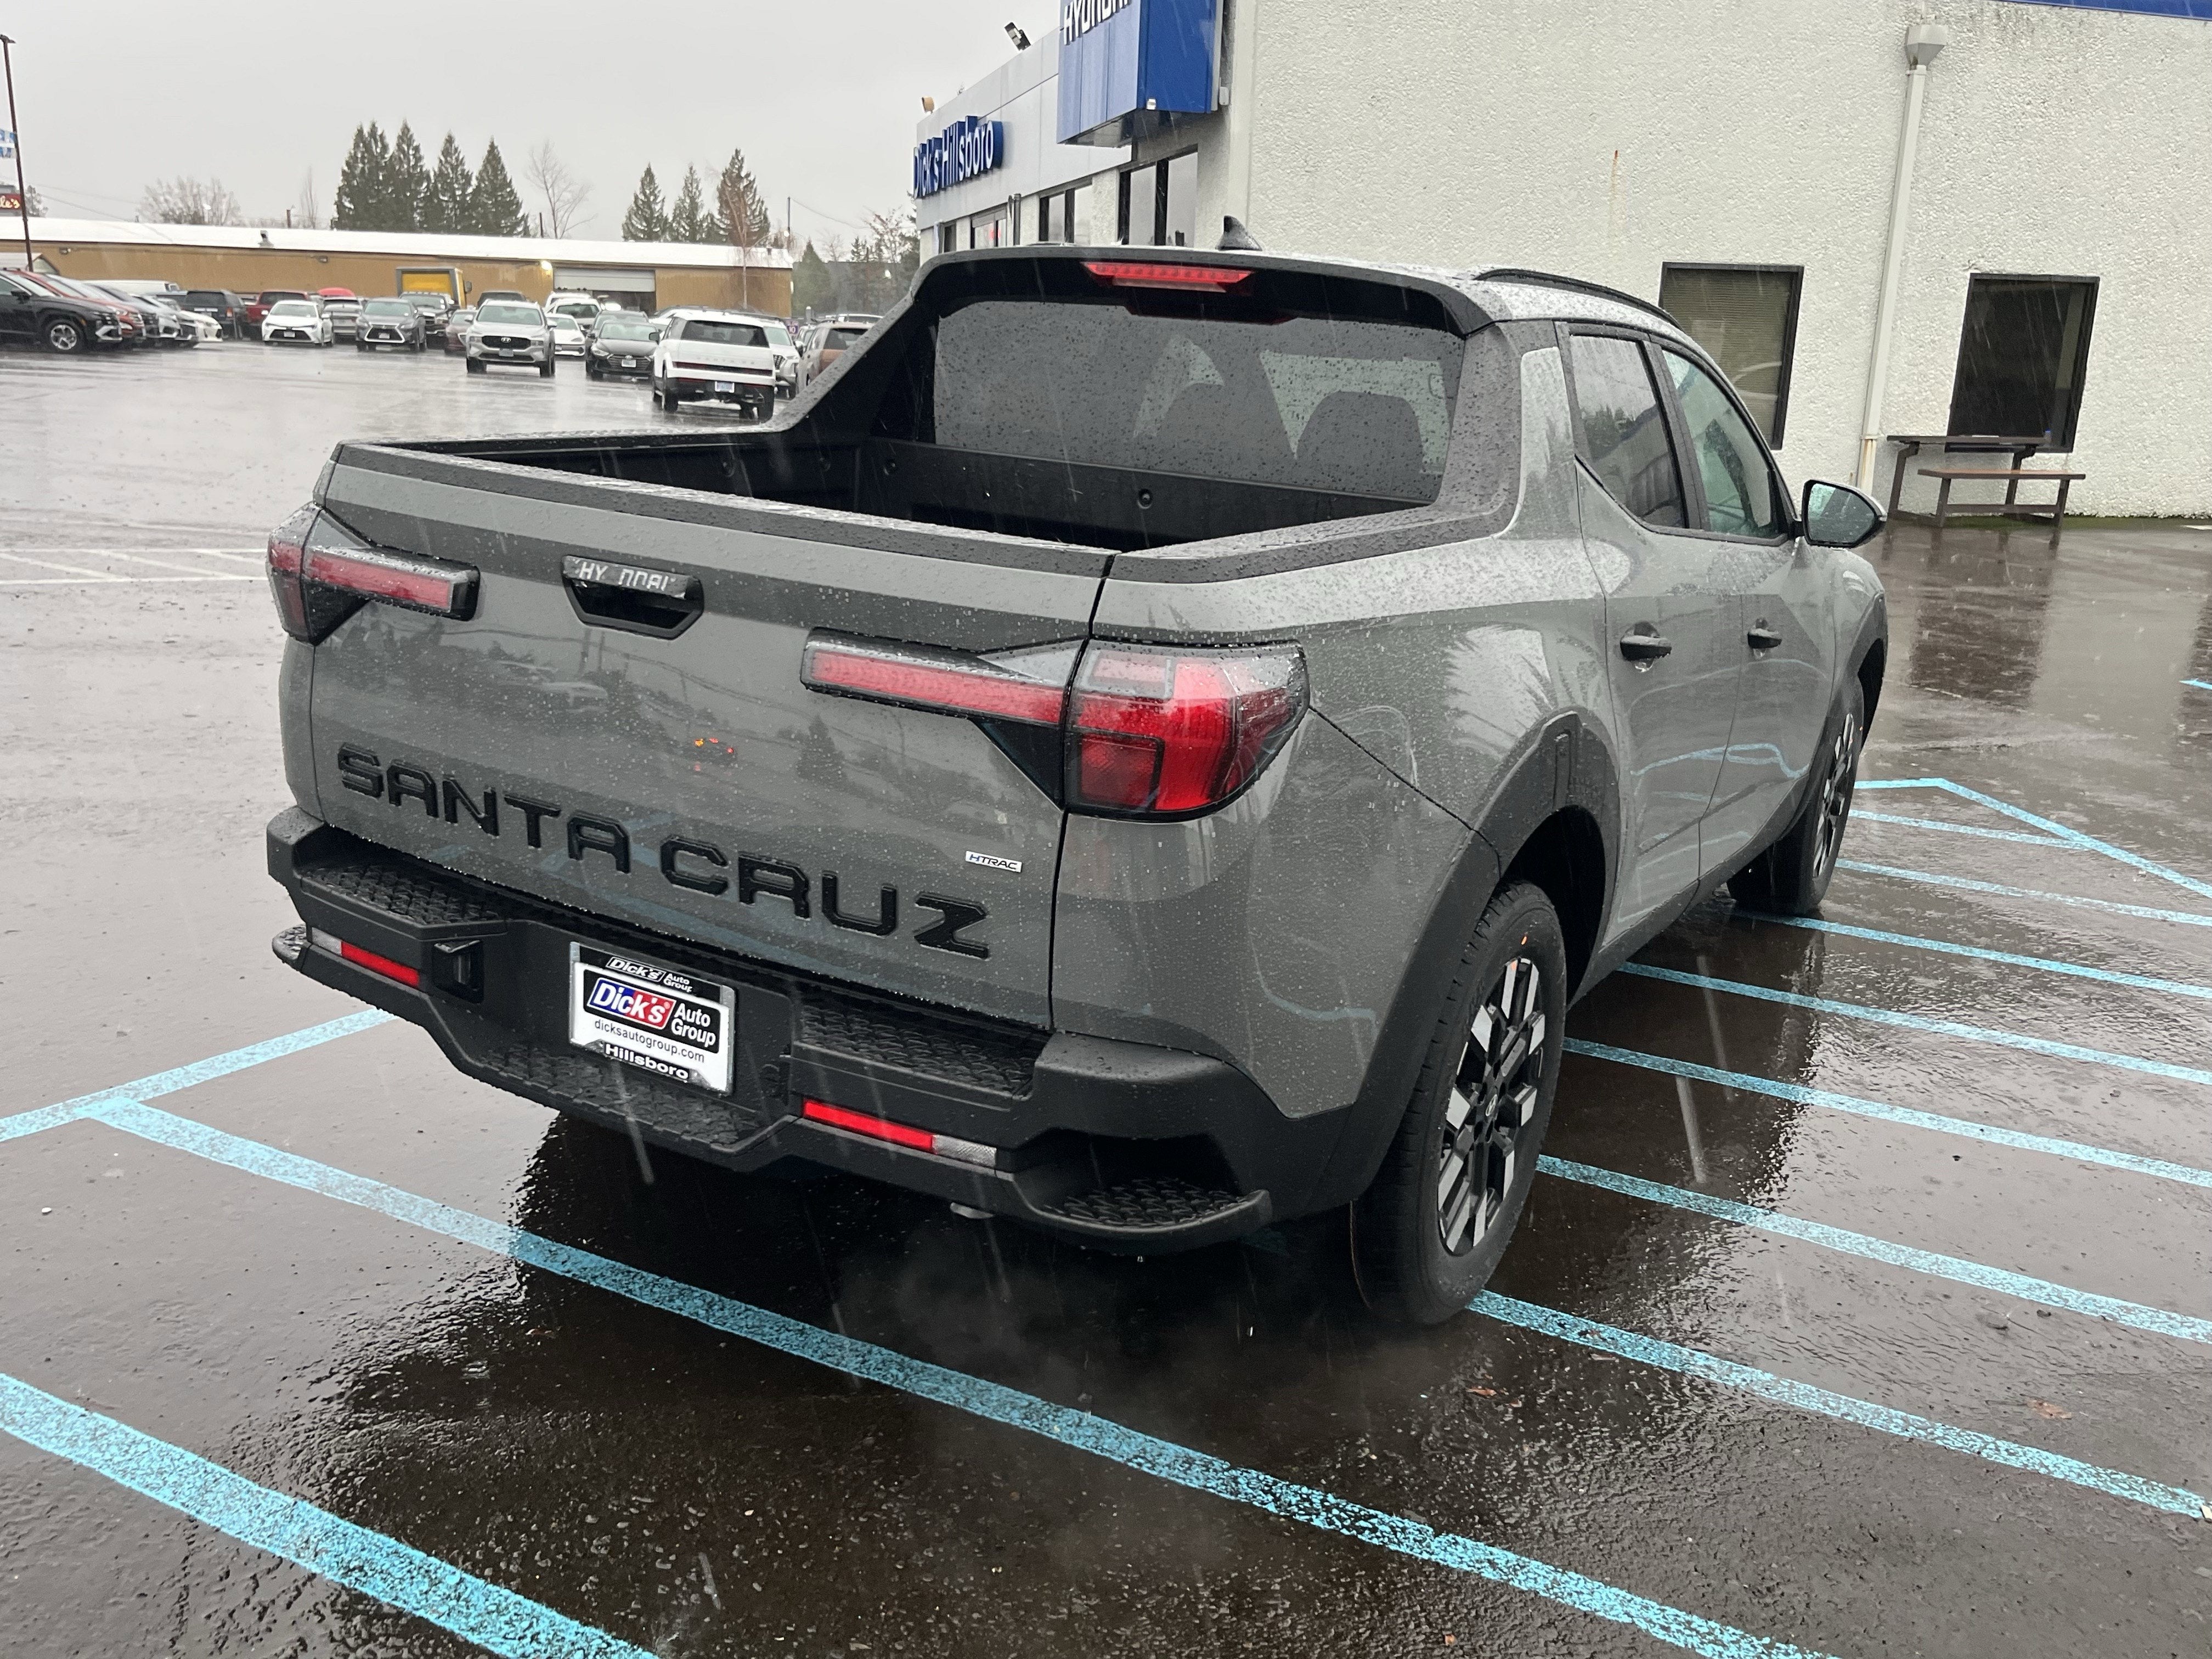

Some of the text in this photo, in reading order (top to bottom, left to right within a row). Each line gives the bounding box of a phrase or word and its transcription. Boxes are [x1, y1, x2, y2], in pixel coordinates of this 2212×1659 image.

[1063, 0, 1128, 45] HYUN
[913, 116, 995, 199] Dick's Hillsboro
[337, 742, 990, 960] SANTA CRUZ
[969, 854, 1018, 870] HTRAC
[610, 959, 659, 980] Dick's
[665, 973, 690, 985] Auto
[593, 982, 666, 1024] Dick's
[674, 1002, 711, 1028] Auto
[594, 1018, 705, 1063] dicksautogroup.com
[671, 1018, 716, 1048] Group
[605, 1043, 689, 1080] Hillsboro
